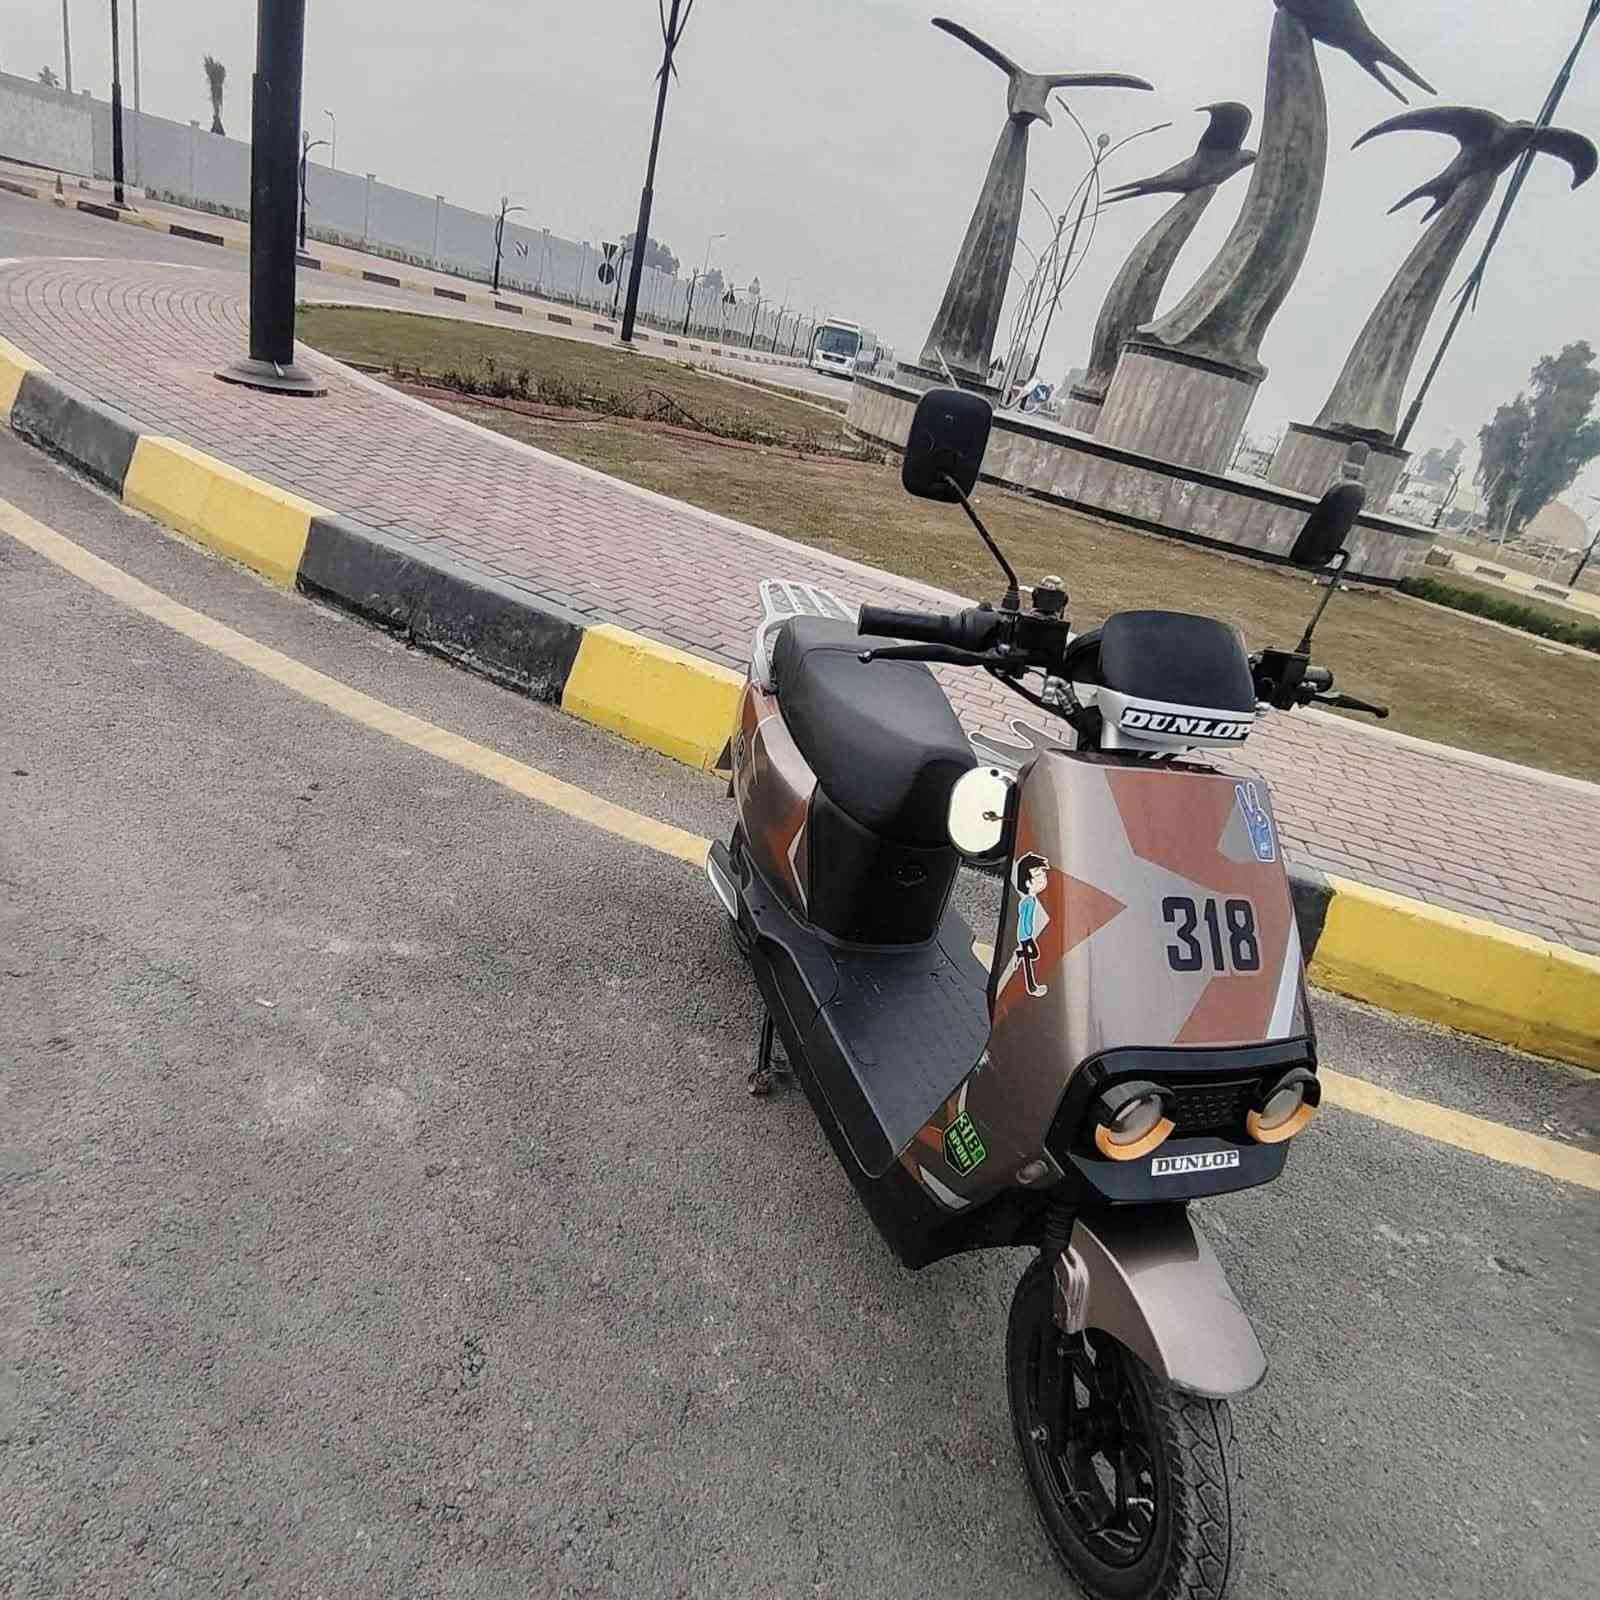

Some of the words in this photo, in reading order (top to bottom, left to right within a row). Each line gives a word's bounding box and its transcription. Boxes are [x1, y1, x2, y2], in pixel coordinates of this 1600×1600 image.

[1121, 709, 1250, 739] DUNLOP
[1162, 896, 1260, 971] 318
[1157, 1152, 1238, 1174] DUNLOP
